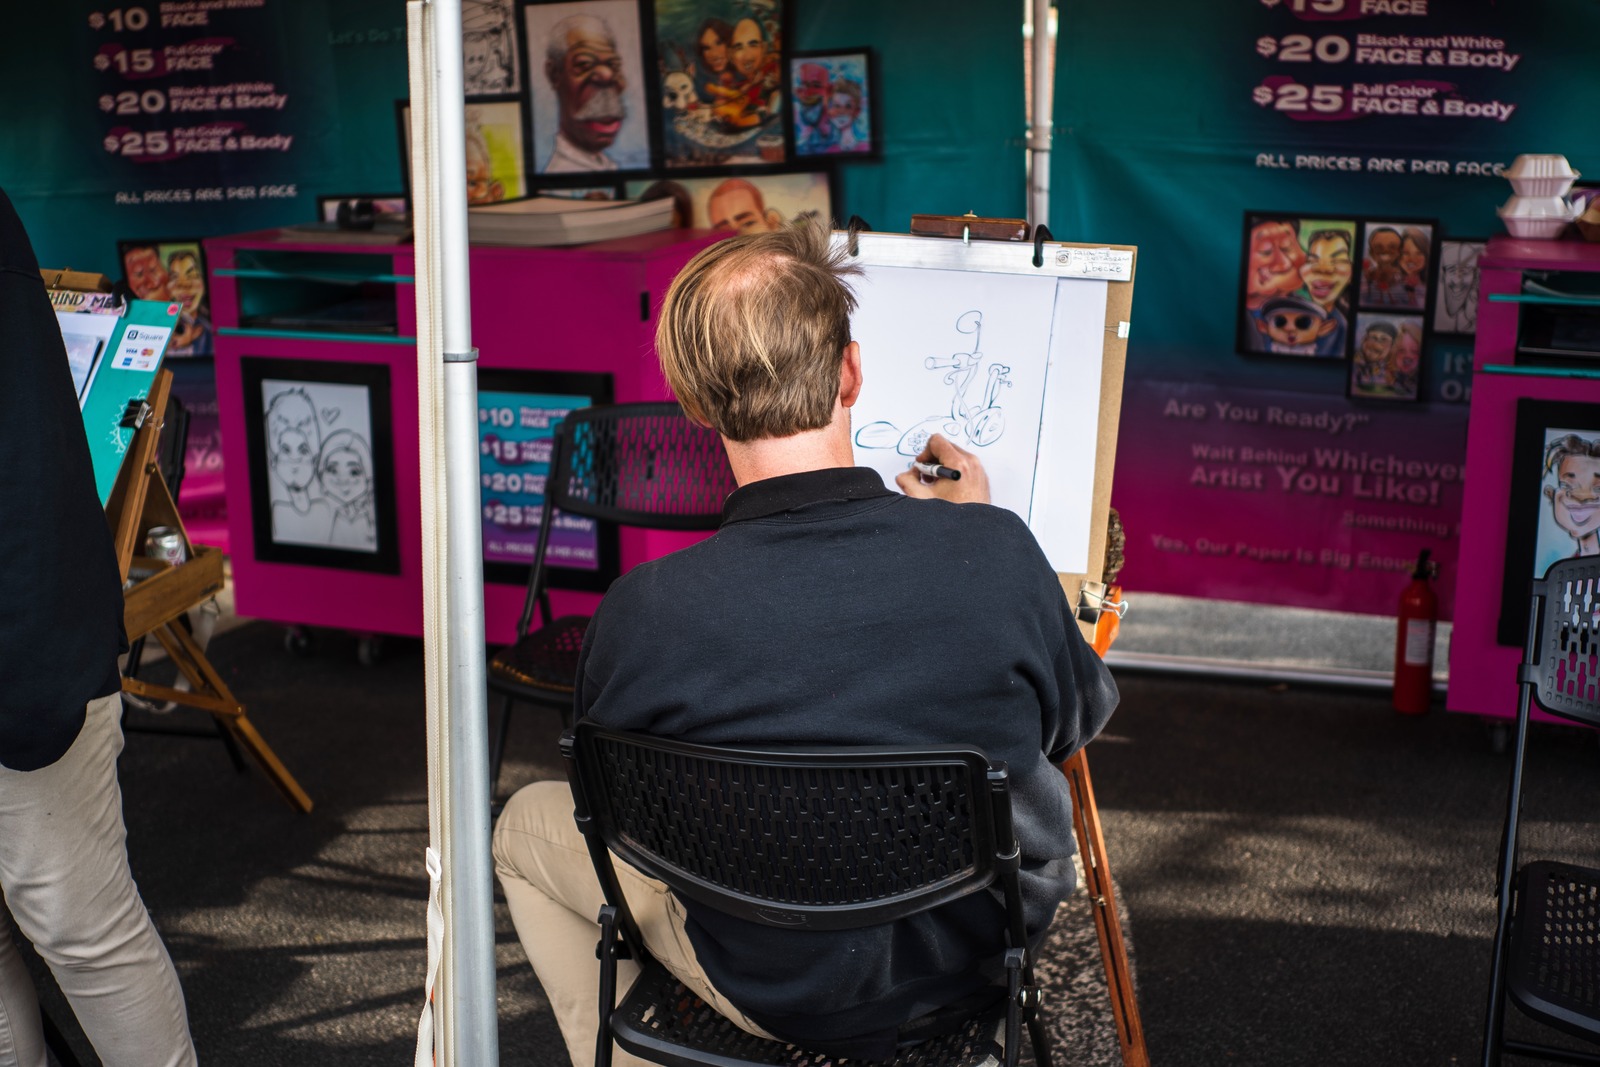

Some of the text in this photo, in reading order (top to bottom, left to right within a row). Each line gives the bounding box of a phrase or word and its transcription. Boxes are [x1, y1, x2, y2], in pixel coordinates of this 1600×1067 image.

[1360, 0, 1428, 16] FACE
[88, 7, 149, 31] $10
[161, 11, 208, 27] FACE
[1257, 34, 1350, 64] $20
[1356, 33, 1505, 50] Black and White
[94, 49, 154, 73] $15
[166, 55, 213, 71] FACE
[1356, 47, 1520, 71] FACE & Body
[169, 82, 274, 98] Black and White
[1253, 83, 1343, 113] $25
[1352, 83, 1437, 98] Full Color
[100, 89, 166, 114] $20
[170, 93, 287, 112] FACE & Body
[1352, 97, 1516, 121] FACE & Body
[173, 126, 233, 138] Full Color
[104, 131, 169, 155] $25
[175, 134, 292, 153] FACE & Body
[1256, 153, 1506, 177] ALL PRICES ARE PER FACE
[115, 184, 297, 204] ALL PRICES ARE PER FACE
[48, 291, 85, 306] HIND
[126, 347, 138, 355] VISA
[479, 407, 514, 427] $10
[521, 418, 549, 428] FACE
[1164, 399, 1369, 434] Are You Ready?"
[191, 449, 221, 467] Yo
[482, 440, 518, 460] $15
[1192, 443, 1234, 461] Wait
[1241, 447, 1308, 467] Behind
[483, 473, 522, 493] $20
[1190, 465, 1441, 503] Artist You Like!
[485, 505, 523, 525] $25
[1342, 509, 1449, 537] Something
[1151, 534, 1191, 555] Yes,
[1195, 537, 1228, 555] Our
[1235, 541, 1290, 563] Paper
[1296, 546, 1313, 563] Is
[1320, 548, 1352, 570] Big
